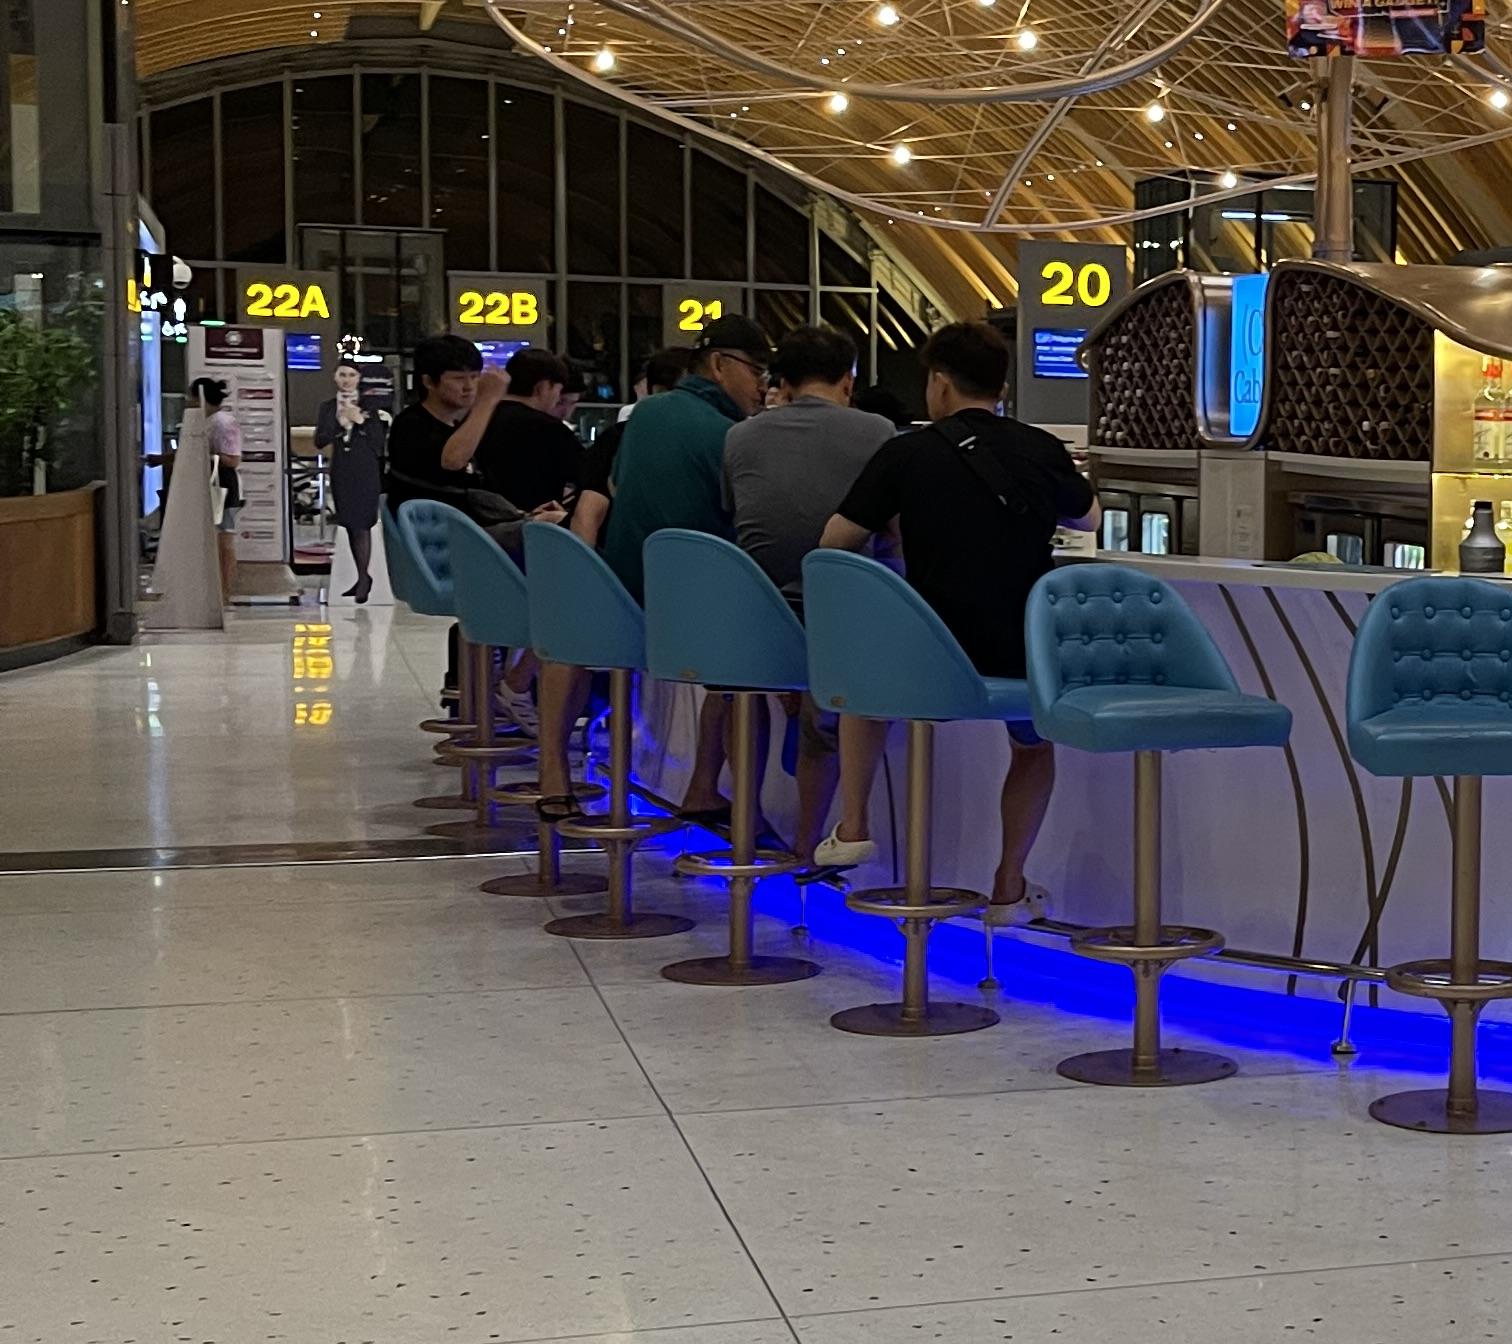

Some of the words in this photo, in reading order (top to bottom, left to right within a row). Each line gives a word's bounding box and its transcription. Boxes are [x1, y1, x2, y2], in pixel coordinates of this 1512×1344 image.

[246, 283, 330, 319] 22A
[1041, 261, 1111, 307] 20
[458, 291, 539, 325] 22B
[679, 299, 722, 331] 21
